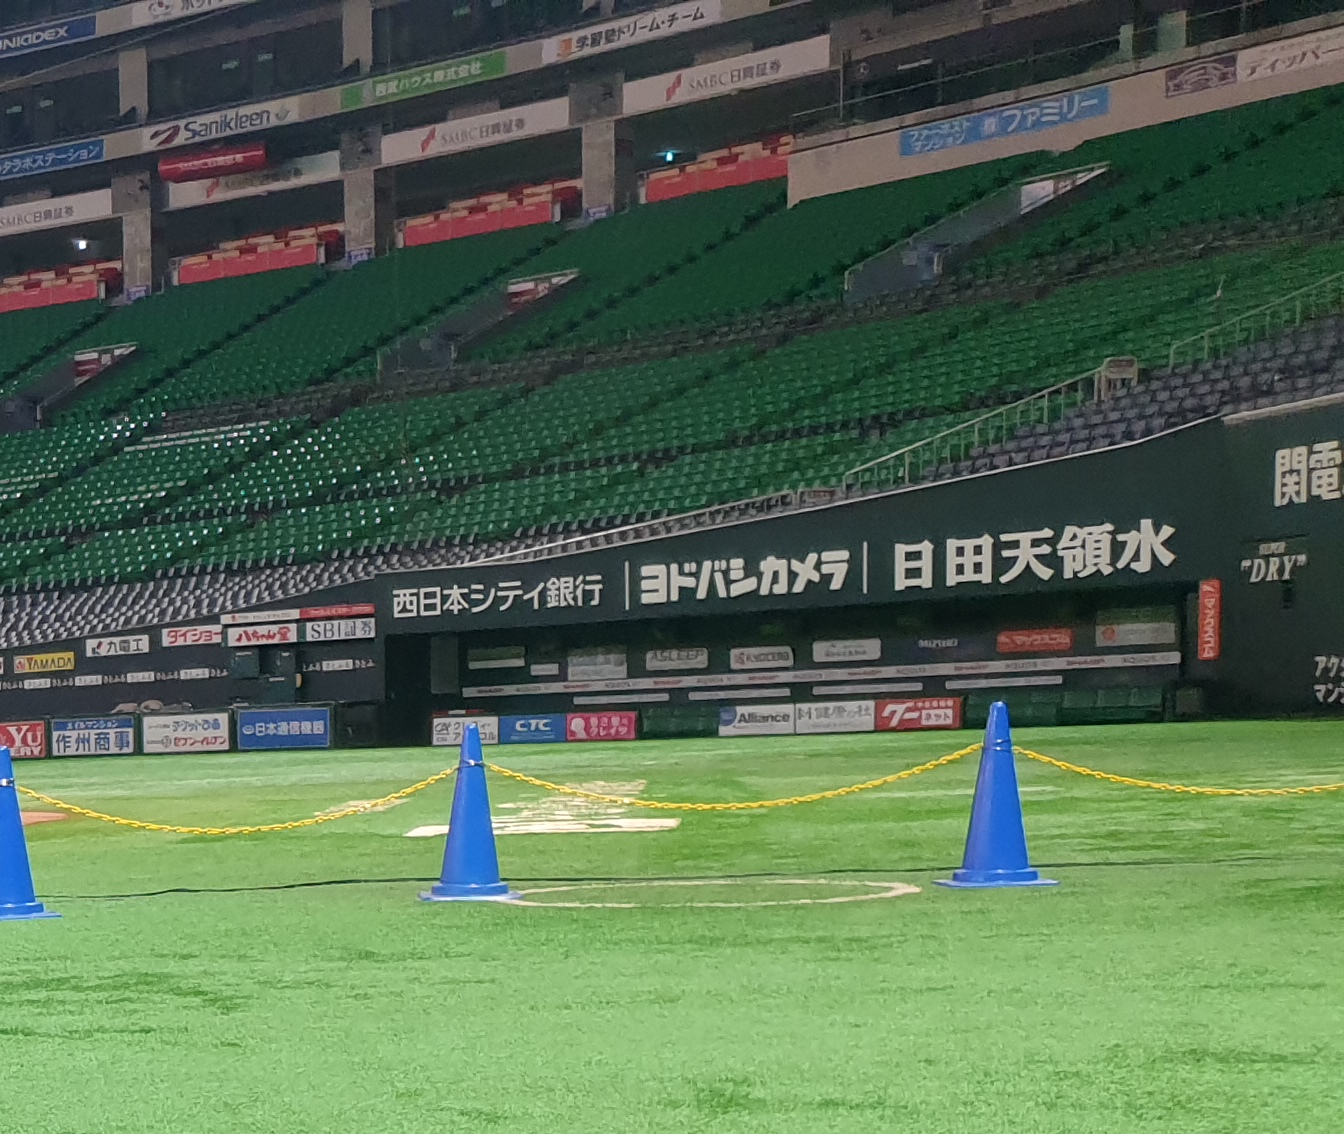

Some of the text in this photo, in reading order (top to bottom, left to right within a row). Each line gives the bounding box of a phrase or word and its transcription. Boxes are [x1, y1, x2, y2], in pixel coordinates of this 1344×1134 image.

[184, 109, 271, 141] Sanikleen
[1274, 440, 1344, 507] 関電
[894, 518, 1177, 591] 日田天領水
[640, 549, 850, 605] ヨドバシカメラ
[392, 574, 603, 619] 西日本シティ銀行
[107, 638, 144, 653] 九電工
[166, 629, 223, 644] ダイショー
[25, 657, 72, 671] YAMADA
[515, 719, 552, 732] CTC
[738, 711, 790, 724] Alliance
[55, 731, 131, 752] 作州商事
